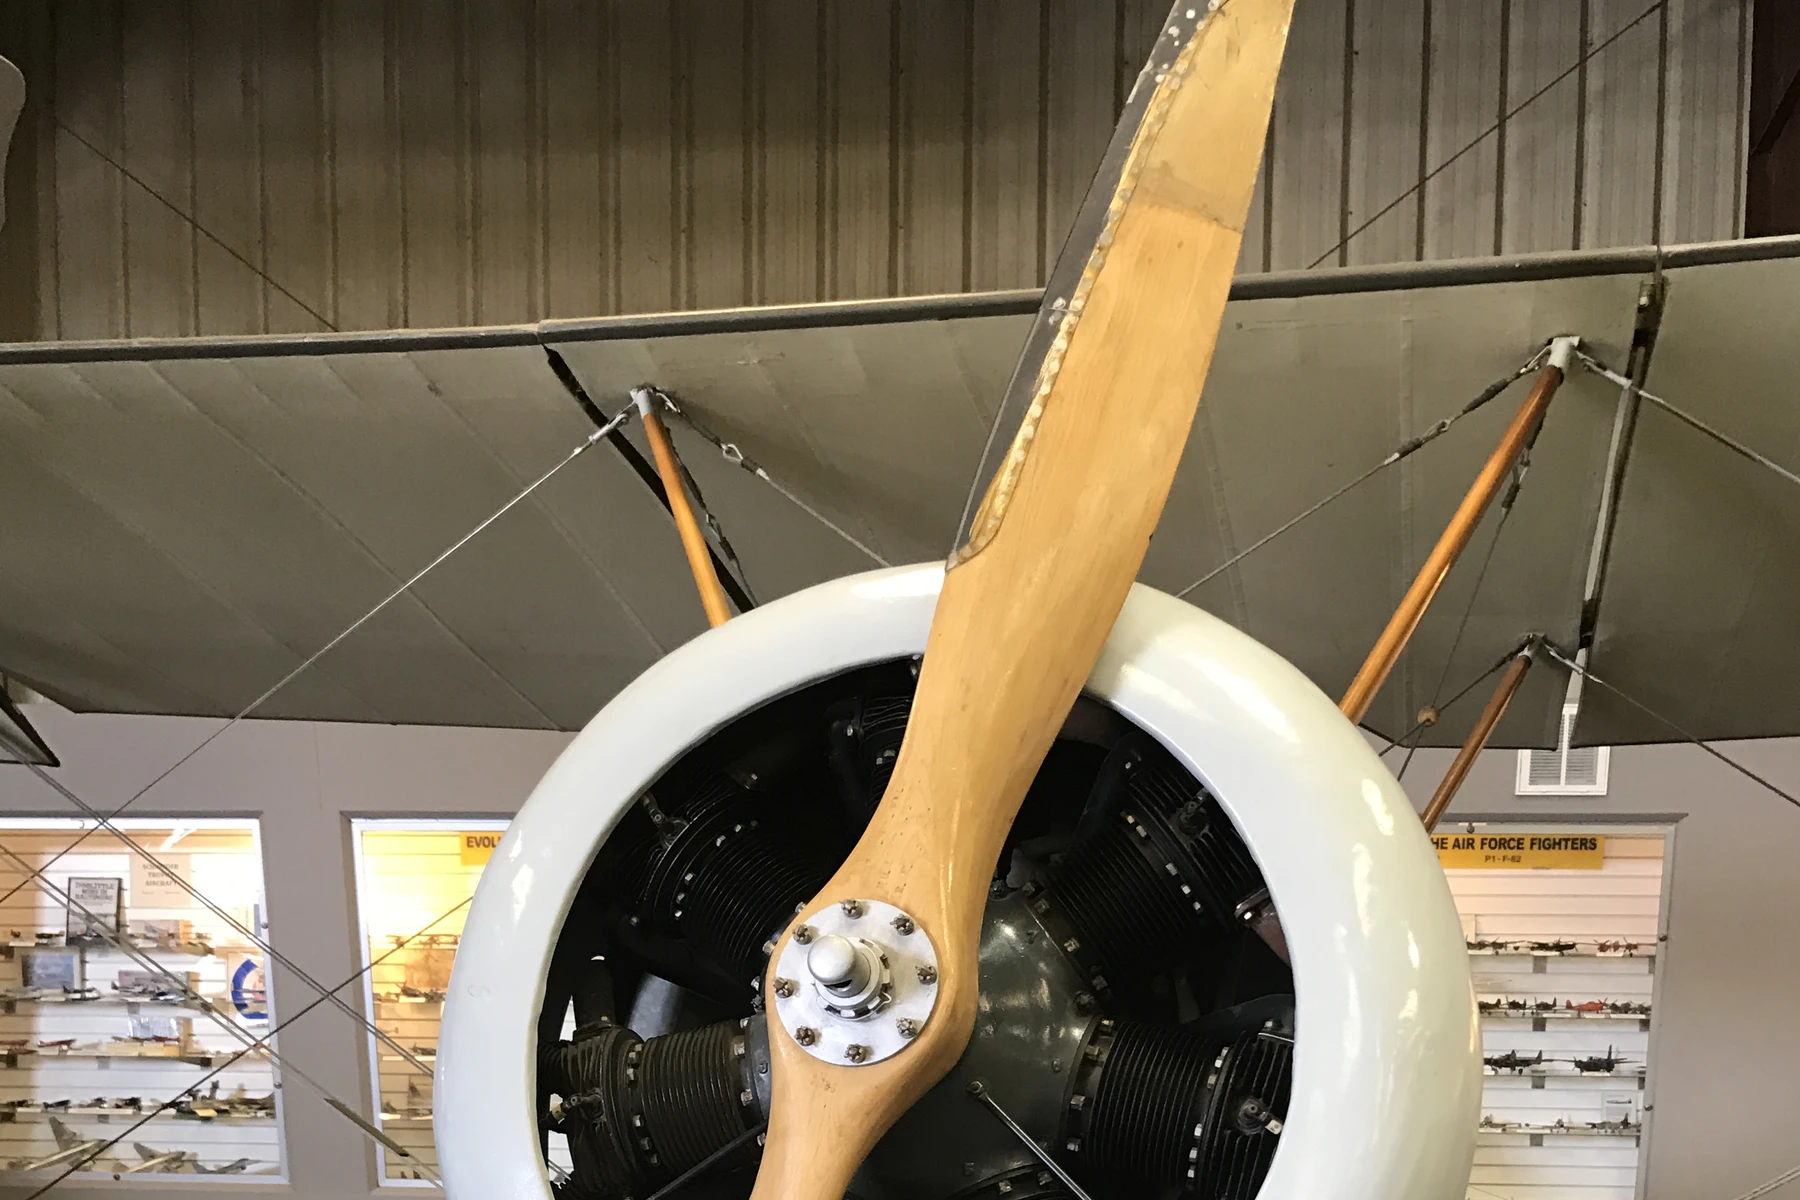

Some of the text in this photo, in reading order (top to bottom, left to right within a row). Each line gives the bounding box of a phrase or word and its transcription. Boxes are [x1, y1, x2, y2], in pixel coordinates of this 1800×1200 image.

[1431, 837, 1597, 851] HE AIR FORCE FIGHTERS
